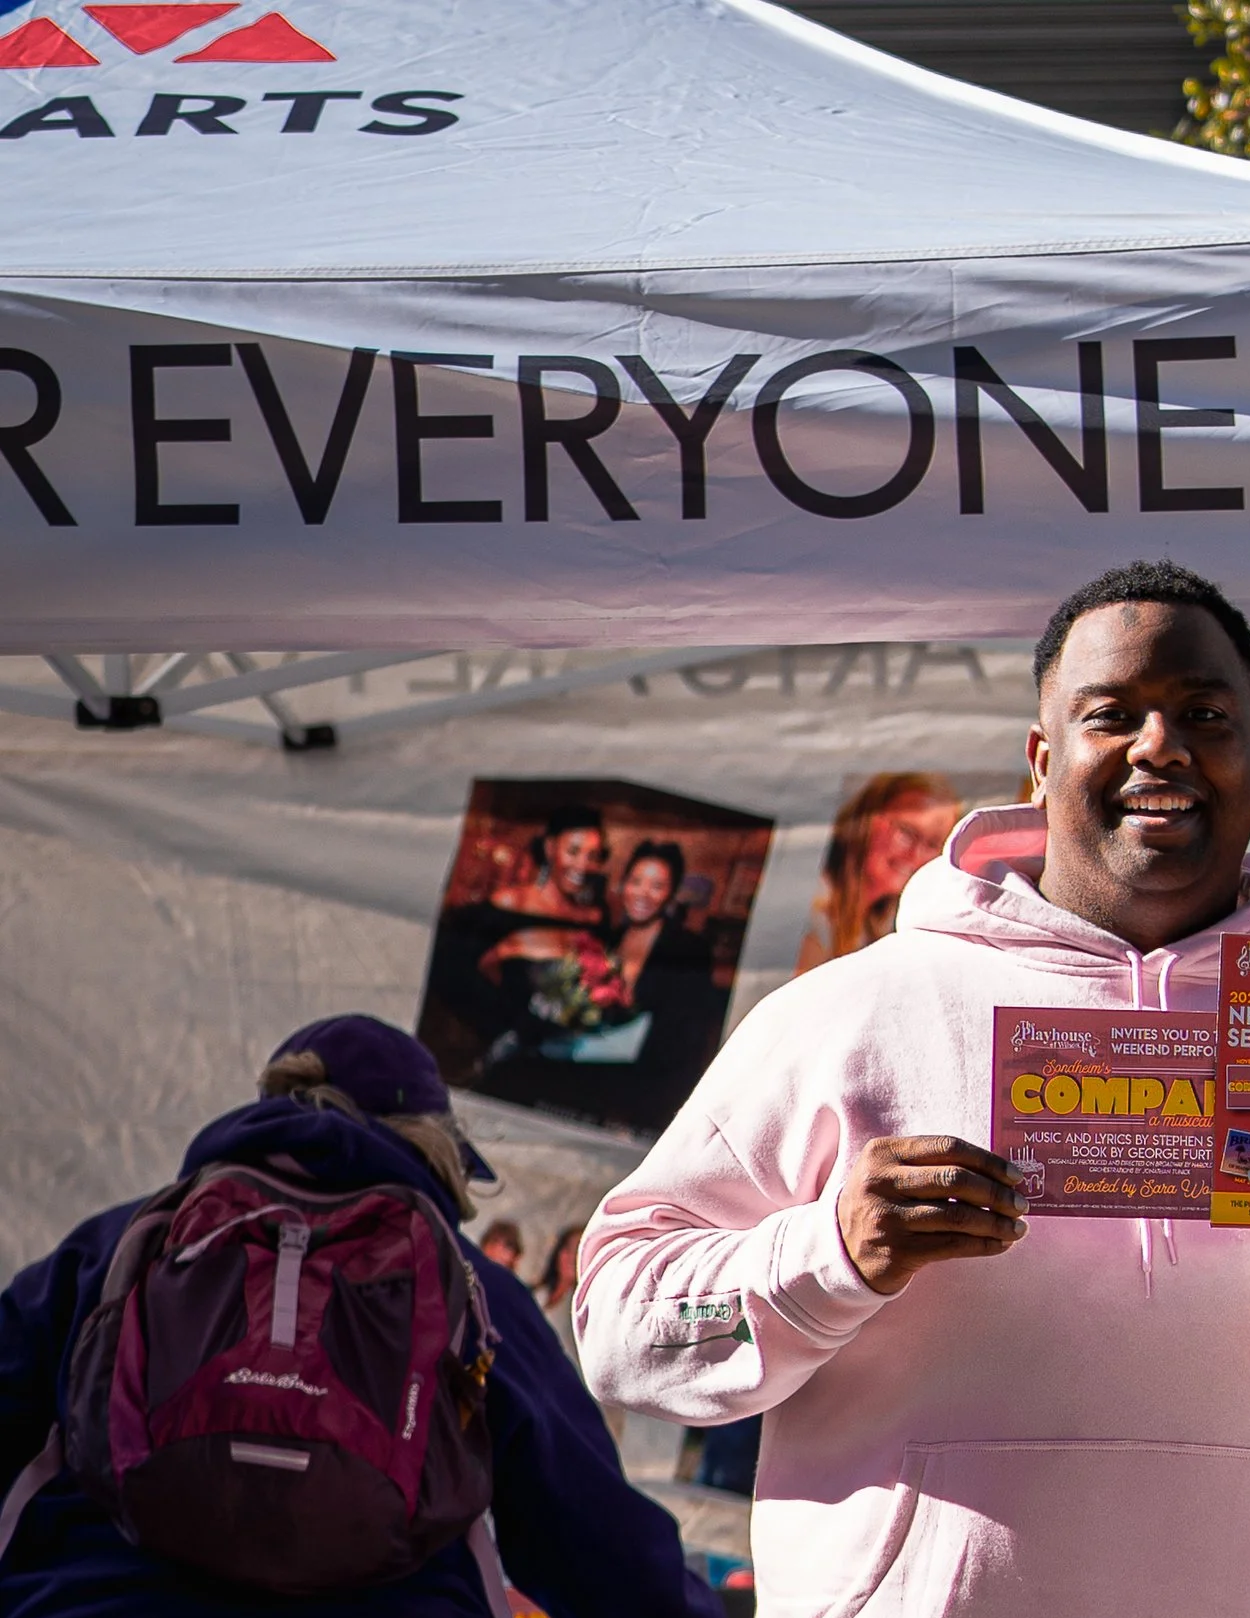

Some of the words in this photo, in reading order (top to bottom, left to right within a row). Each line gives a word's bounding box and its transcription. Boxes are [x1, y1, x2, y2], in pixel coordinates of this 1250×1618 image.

[0, 90, 466, 138] ARTS
[1019, 1020, 1035, 1031] The
[1020, 1025, 1092, 1044] Playhouse
[1111, 1027, 1158, 1041] INVITES
[1158, 1028, 1189, 1042] YOU
[1193, 1030, 1209, 1042] TO
[1111, 1042, 1170, 1056] WEEKEND
[1173, 1044, 1216, 1058] PERFO
[1042, 1058, 1110, 1076] Sondheim's
[1149, 1115, 1159, 1127] a
[1163, 1113, 1215, 1128] musical
[1024, 1131, 1062, 1144] MUSIC
[1065, 1132, 1091, 1145] AND
[1094, 1132, 1131, 1146] LYRICS
[1136, 1133, 1149, 1146] BY
[1152, 1135, 1206, 1148] STEPHEN
[1072, 1146, 1107, 1159] BOOK
[1110, 1146, 1125, 1159] BY
[1127, 1146, 1180, 1161] GEORGE
[1182, 1148, 1212, 1161] FURT
[1120, 1158, 1145, 1168] DIRECTED
[1145, 1160, 1155, 1168] ON
[1063, 1174, 1119, 1195] Directed
[1121, 1175, 1138, 1198] by
[1139, 1177, 1178, 1198] Sara
[1181, 1178, 1212, 1199] Wo
